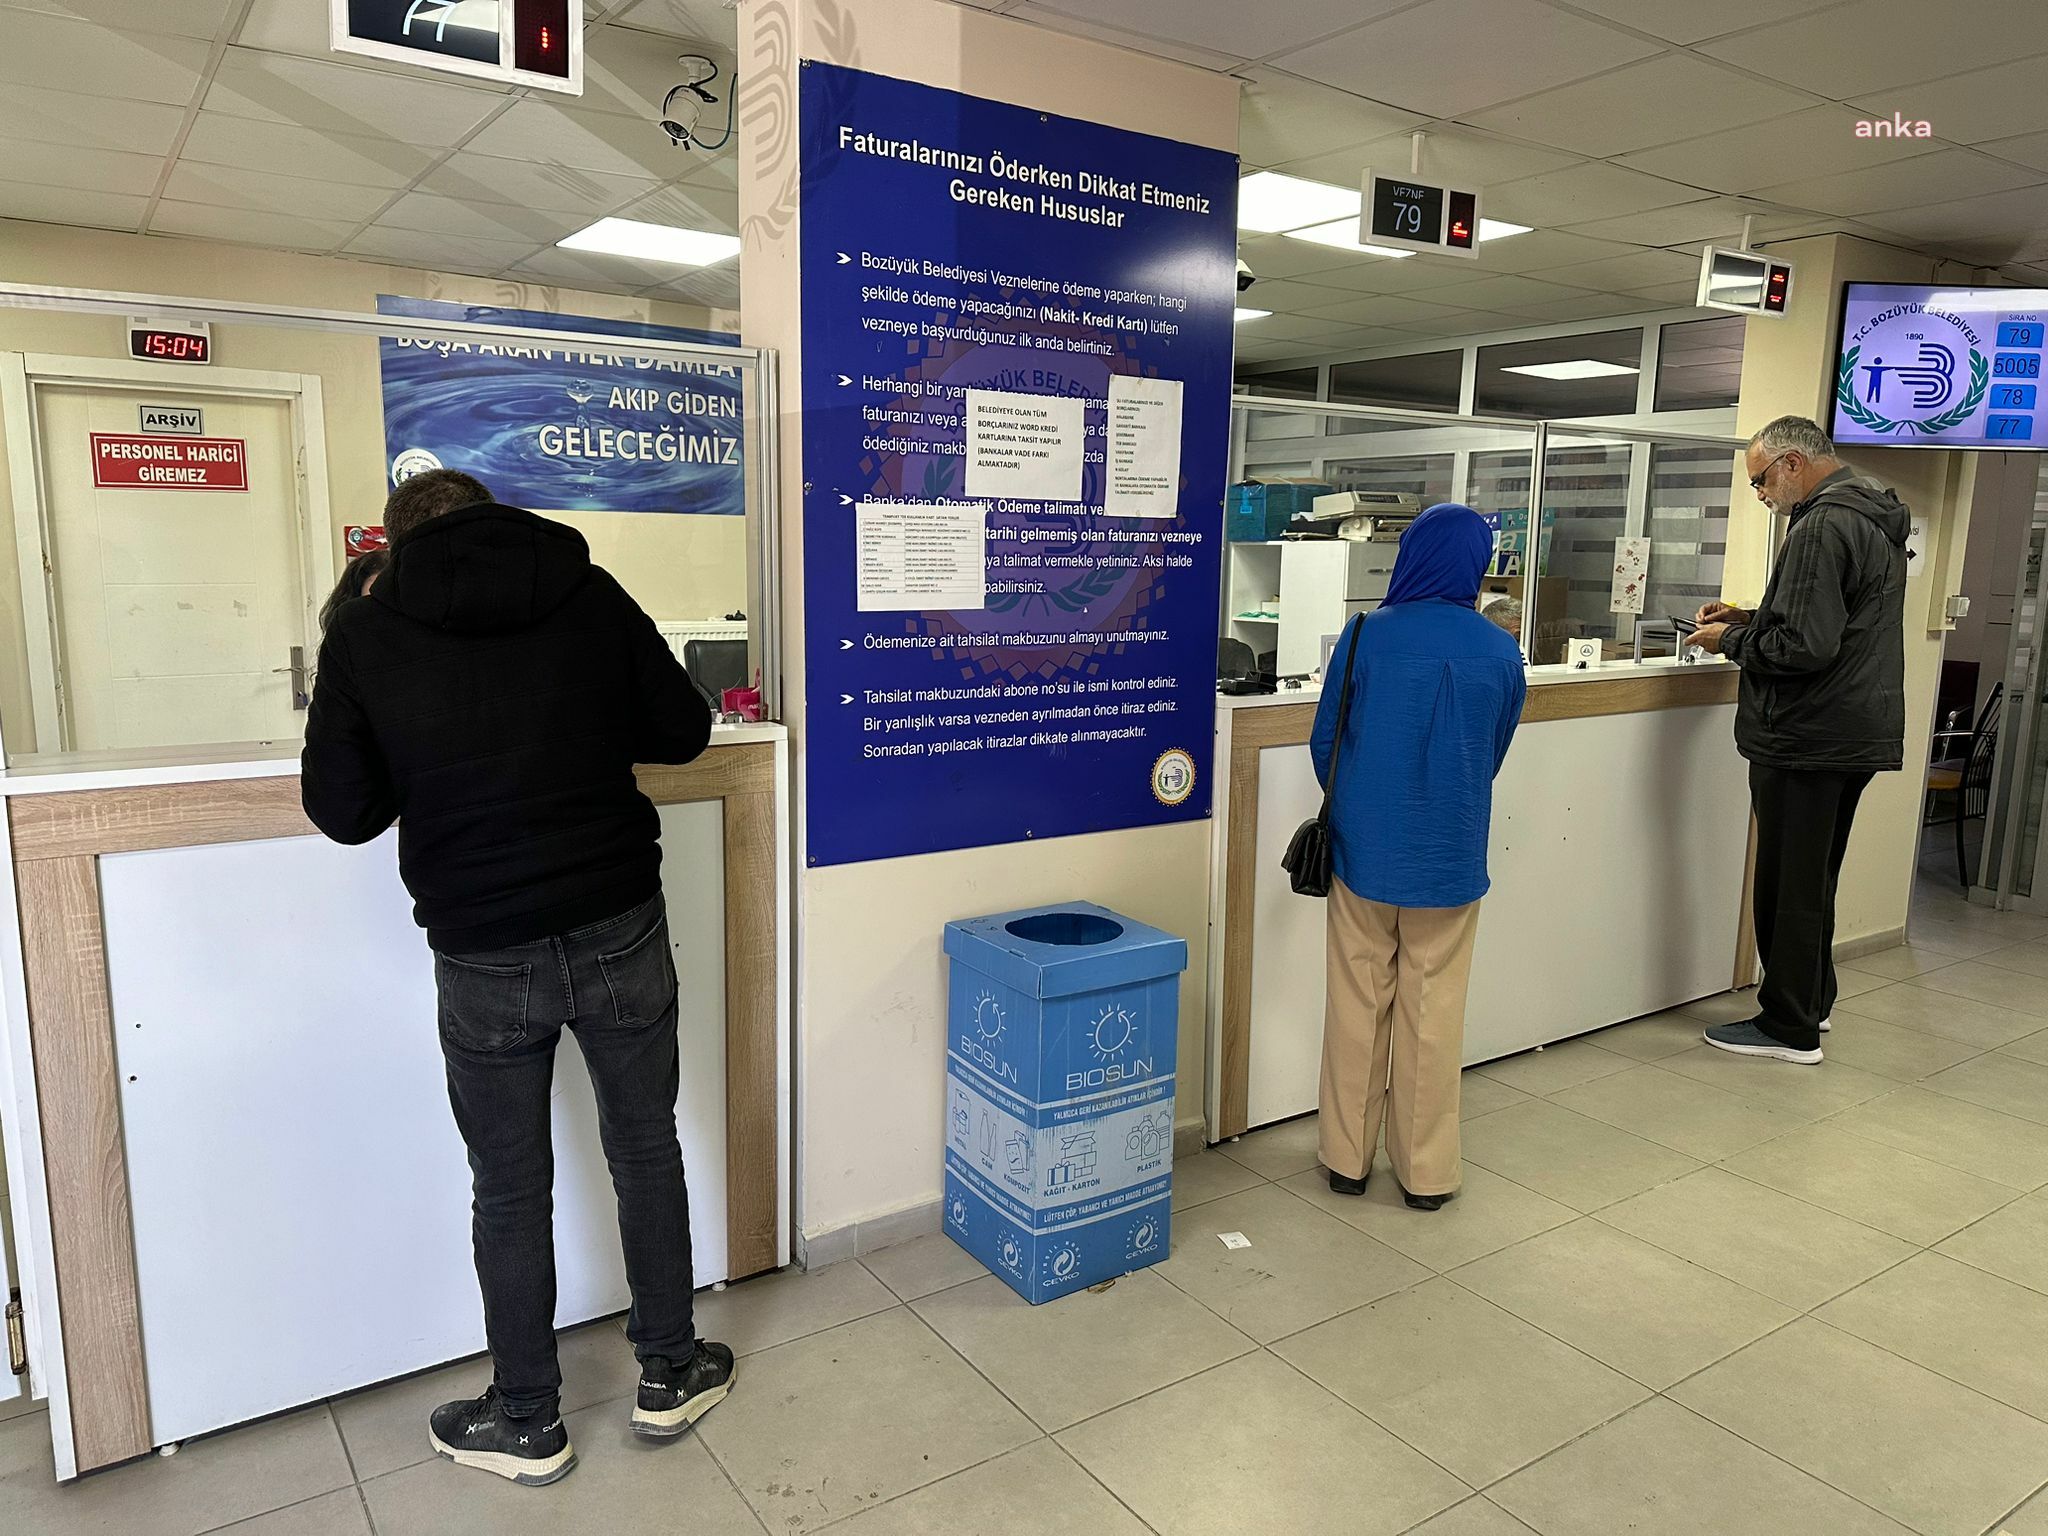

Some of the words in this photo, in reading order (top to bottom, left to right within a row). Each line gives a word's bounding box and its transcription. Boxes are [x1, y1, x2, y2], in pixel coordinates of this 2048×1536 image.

[839, 125, 983, 174] Faturalarınızı
[989, 150, 1072, 190] Öderken
[1078, 171, 1136, 201] Dikkat
[1141, 183, 1210, 214] Etmeniz
[950, 179, 1034, 213] Gereken
[1041, 194, 1125, 228] Hususlar
[1393, 202, 1421, 233] 79
[861, 251, 920, 275] Bozüyük
[923, 260, 987, 284] Belediyesi
[991, 270, 1059, 293] Veznelerine
[1062, 281, 1101, 299] ödeme
[1104, 289, 1156, 307] yaparken;
[1159, 293, 1187, 312] hangi
[861, 285, 909, 302] şekilde
[912, 290, 957, 309] ödeme
[960, 298, 1036, 319] yapacağınızı
[1039, 306, 1080, 324] (Nakit-
[1082, 311, 1114, 328] Kredi
[1117, 317, 1148, 335] Kartı)
[1150, 320, 1179, 335] lütfen
[2026, 314, 2037, 322] NO
[1852, 325, 1872, 343] T.C.
[1871, 302, 1926, 328] BOZÜYÜK
[1928, 305, 1982, 347] BELEDİYESİ
[145, 335, 203, 357] 15:04
[861, 317, 918, 337] vezneye
[922, 321, 1016, 346] başvurduğunuz
[1019, 332, 1032, 347] ilk
[1035, 335, 1064, 350] anda
[1067, 338, 1115, 356] belirtiniz.
[2009, 328, 2031, 344] 79
[1994, 358, 2039, 375] 5005
[862, 374, 923, 398] Herhangi
[926, 380, 943, 396] bir
[608, 386, 660, 411] AKIP
[667, 387, 736, 418] GİDEN
[2002, 388, 2023, 405] 78
[145, 413, 197, 428] ARŞİV
[862, 405, 924, 424] faturanızı
[928, 413, 958, 429] veya
[977, 405, 1014, 416] BELEDİYEYE
[1014, 408, 1032, 417] OLAN
[1032, 409, 1047, 418] TÜM
[977, 420, 1019, 430] BORÇLARINIZ
[1019, 422, 1039, 432] WORD
[1040, 423, 1058, 433] KREDİ
[1998, 419, 2020, 435] 77
[538, 423, 739, 465] GELECEĞİMİZ
[862, 436, 929, 455] ödediğiniz
[977, 432, 1017, 443] KARTLARINA
[1018, 434, 1038, 444] TAKSİT
[1039, 437, 1062, 446] YAPILIR
[100, 443, 183, 461] PERSONEL
[187, 444, 238, 463] HARİCİ
[977, 447, 1013, 456] (BANKALAR
[1014, 448, 1031, 457] VADE
[1031, 450, 1050, 458] FARKI
[138, 463, 207, 483] GİREMEZ
[977, 460, 1021, 470] ALMAKTADIR)
[997, 498, 1041, 514] Ödeme
[1045, 501, 1087, 515] talimatı
[985, 526, 1017, 540] tarihi
[1020, 527, 1078, 544] gelmemiş
[1080, 529, 1105, 542] olan
[1108, 529, 1158, 542] faturanızı
[1161, 532, 1203, 545] vezneye
[1004, 554, 1042, 567] talimat
[1044, 554, 1093, 567] vermekle
[1096, 555, 1141, 570] yetininiz.
[1142, 555, 1164, 567] Aksi
[1166, 555, 1193, 567] halde
[863, 633, 936, 649] Ödemenize
[939, 634, 954, 647] ait
[957, 633, 999, 647] tahsilat
[1002, 632, 1066, 646] makbuzunu
[1069, 631, 1104, 645] almayı
[1106, 630, 1170, 645] unutmayınız.
[863, 689, 912, 704] Tahsilat
[915, 685, 1001, 702] makbuzundaki
[1003, 684, 1039, 697] abone
[1073, 680, 1086, 693] ile
[1088, 679, 1109, 692] ismi
[1111, 678, 1145, 691] kontrol
[1147, 676, 1179, 689] ediniz.
[863, 717, 882, 731] Bir
[885, 714, 935, 733] yanlışlık
[938, 714, 971, 727] varsa
[974, 709, 1029, 724] vezneden
[1031, 706, 1091, 723] ayrılmadan
[1093, 704, 1119, 716] önce
[1121, 702, 1145, 714] itiraz
[1147, 700, 1179, 713] ediniz.
[863, 742, 924, 758] Sonradan
[928, 737, 983, 757] yapılacak
[986, 734, 1027, 749] itirazlar
[1029, 732, 1068, 746] dikkate
[1070, 726, 1147, 743] alınmayacaktır.
[961, 1034, 1017, 1084] BIOSUN
[1066, 1056, 1152, 1090] BIOSUN
[1136, 1159, 1162, 1173] PLASTİK
[1043, 1185, 1066, 1197] KAĞIT
[1072, 1178, 1101, 1191] KARTON
[1043, 1211, 1065, 1223] LÜTFEN
[1100, 1200, 1108, 1208] VE
